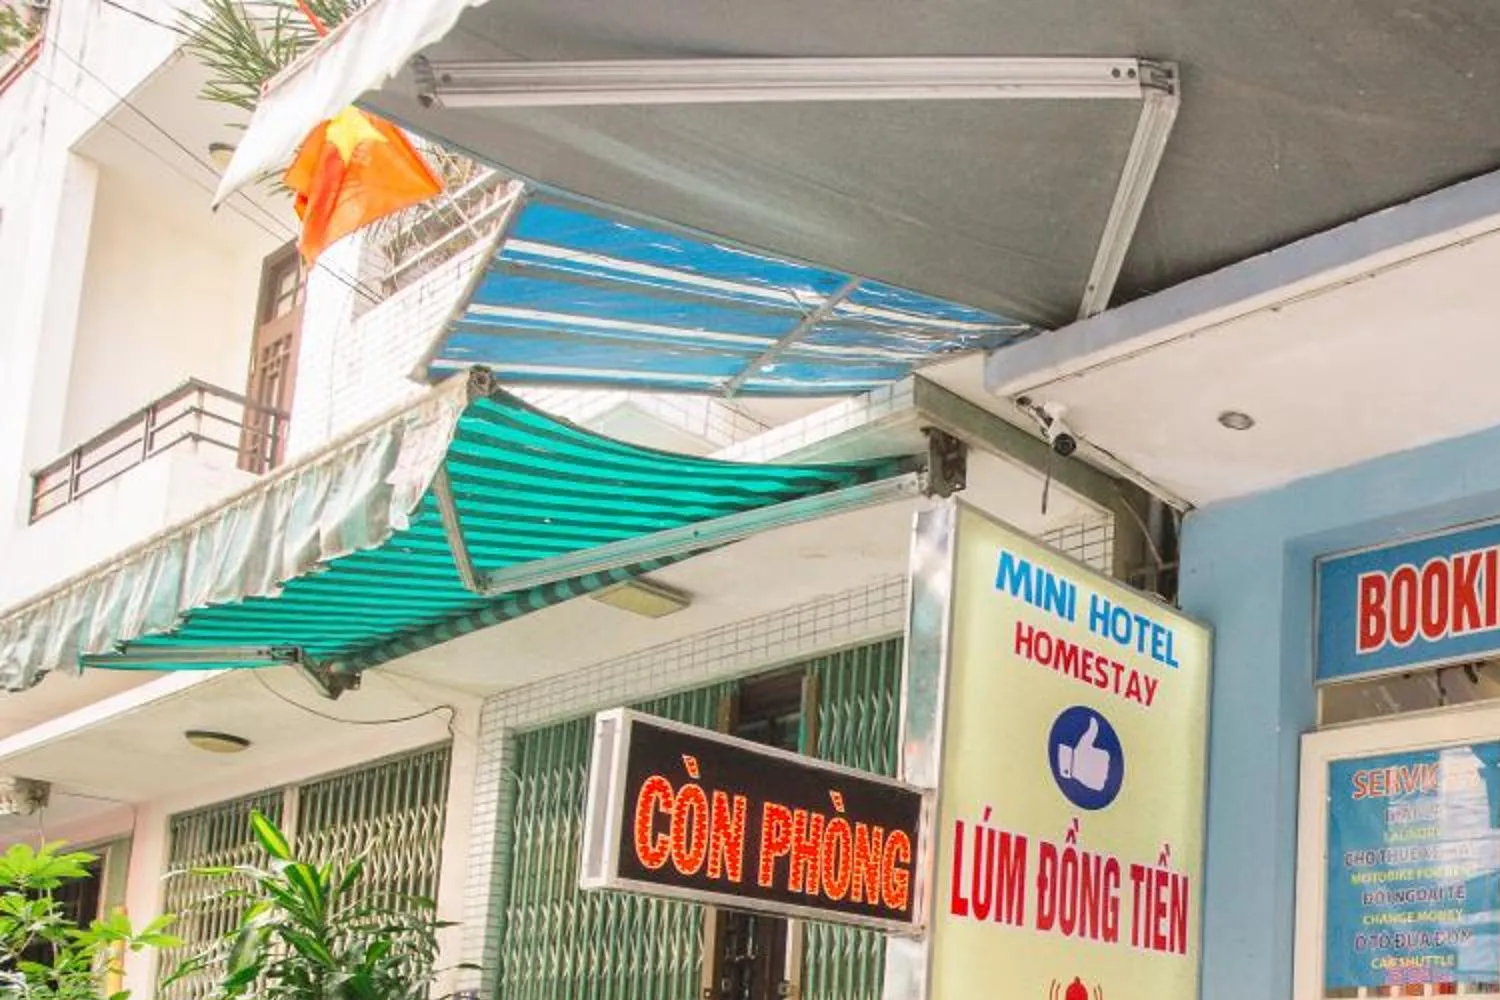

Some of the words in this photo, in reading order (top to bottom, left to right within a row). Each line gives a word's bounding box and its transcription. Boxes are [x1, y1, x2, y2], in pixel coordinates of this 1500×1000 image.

[995, 551, 1076, 622] MINI
[1089, 593, 1180, 668] HOTEL
[1014, 621, 1158, 707] HOMESTAY
[634, 753, 747, 883] CÒN
[758, 789, 910, 911] PHÒNG
[951, 806, 1027, 926] LÚM
[1036, 817, 1121, 943] ĐỒNG
[1130, 843, 1189, 954] TIỀN
